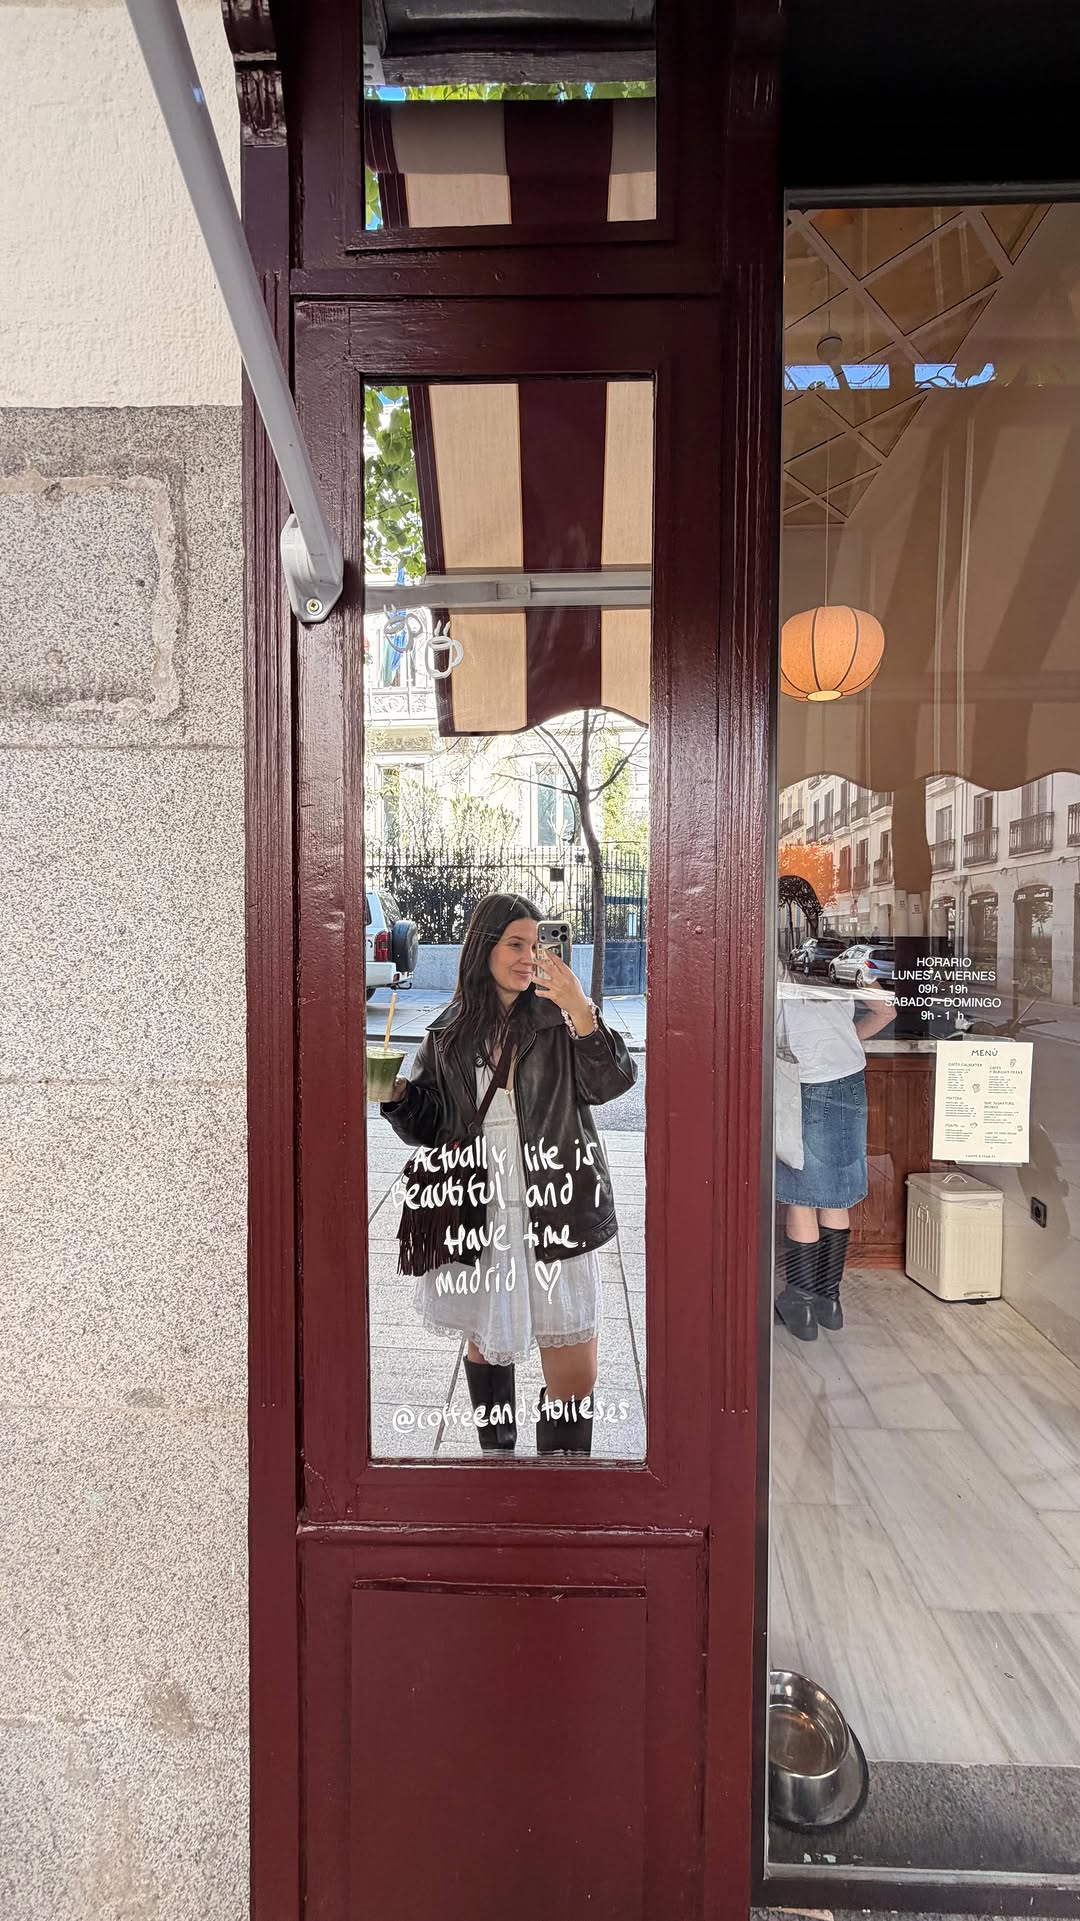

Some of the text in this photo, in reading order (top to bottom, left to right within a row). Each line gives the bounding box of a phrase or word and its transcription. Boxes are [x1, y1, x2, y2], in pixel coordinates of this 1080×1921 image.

[916, 957, 972, 968] HORARIO
[891, 970, 996, 981] LUNES A VIERNES
[918, 984, 938, 994] 09h
[949, 984, 968, 994] 19h
[884, 997, 934, 1007] SABADO
[944, 997, 1002, 1008] DOMINGO
[920, 1010, 935, 1020] 9h
[524, 1137, 564, 1172] life
[574, 1139, 598, 1171] is
[391, 1171, 506, 1210] Beautiful
[525, 1173, 573, 1208] and
[444, 1221, 512, 1256] Have
[435, 1256, 516, 1297] madrid
